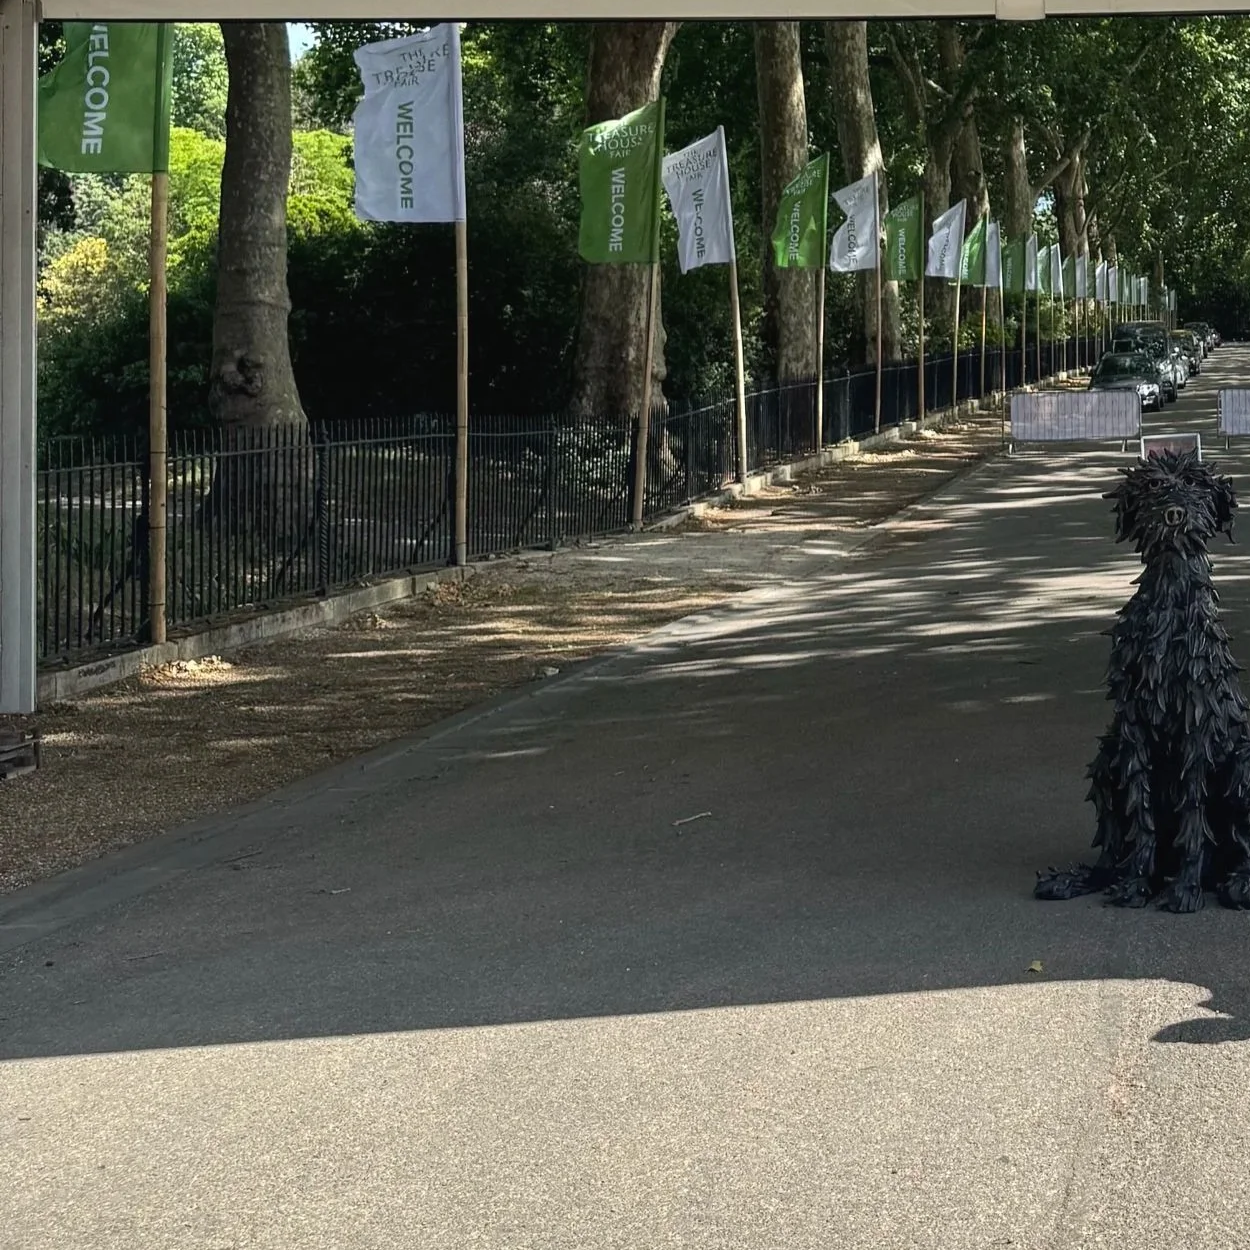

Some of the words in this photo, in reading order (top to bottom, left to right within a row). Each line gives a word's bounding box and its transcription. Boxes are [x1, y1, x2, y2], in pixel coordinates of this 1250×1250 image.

[396, 100, 414, 210] WELCOME
[609, 167, 625, 253] WELCOME
[898, 228, 907, 276] WELCOME
